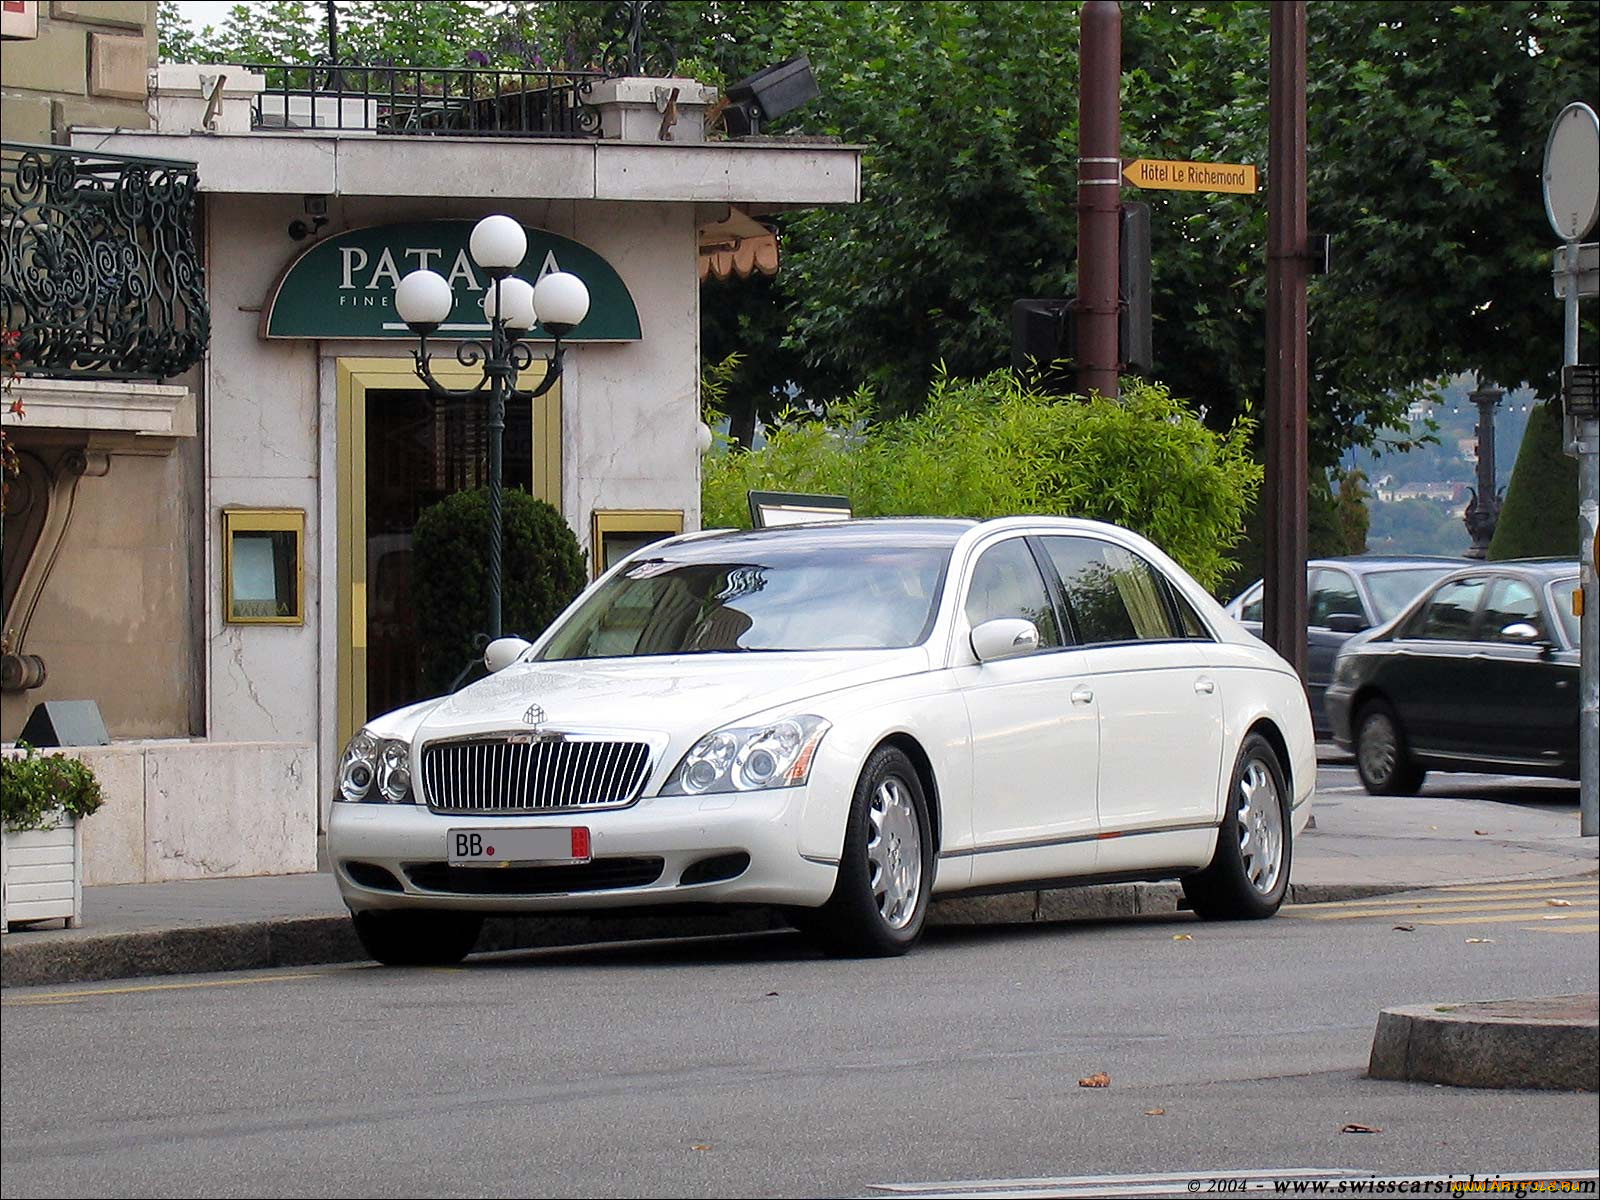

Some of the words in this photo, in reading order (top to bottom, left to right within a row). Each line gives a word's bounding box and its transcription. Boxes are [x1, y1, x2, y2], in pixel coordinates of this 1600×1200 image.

[1140, 163, 1168, 181] Hôtel
[1172, 165, 1184, 183] Le
[1188, 166, 1245, 186] Richemond
[338, 247, 567, 291] PATAA
[339, 296, 388, 307] FINE
